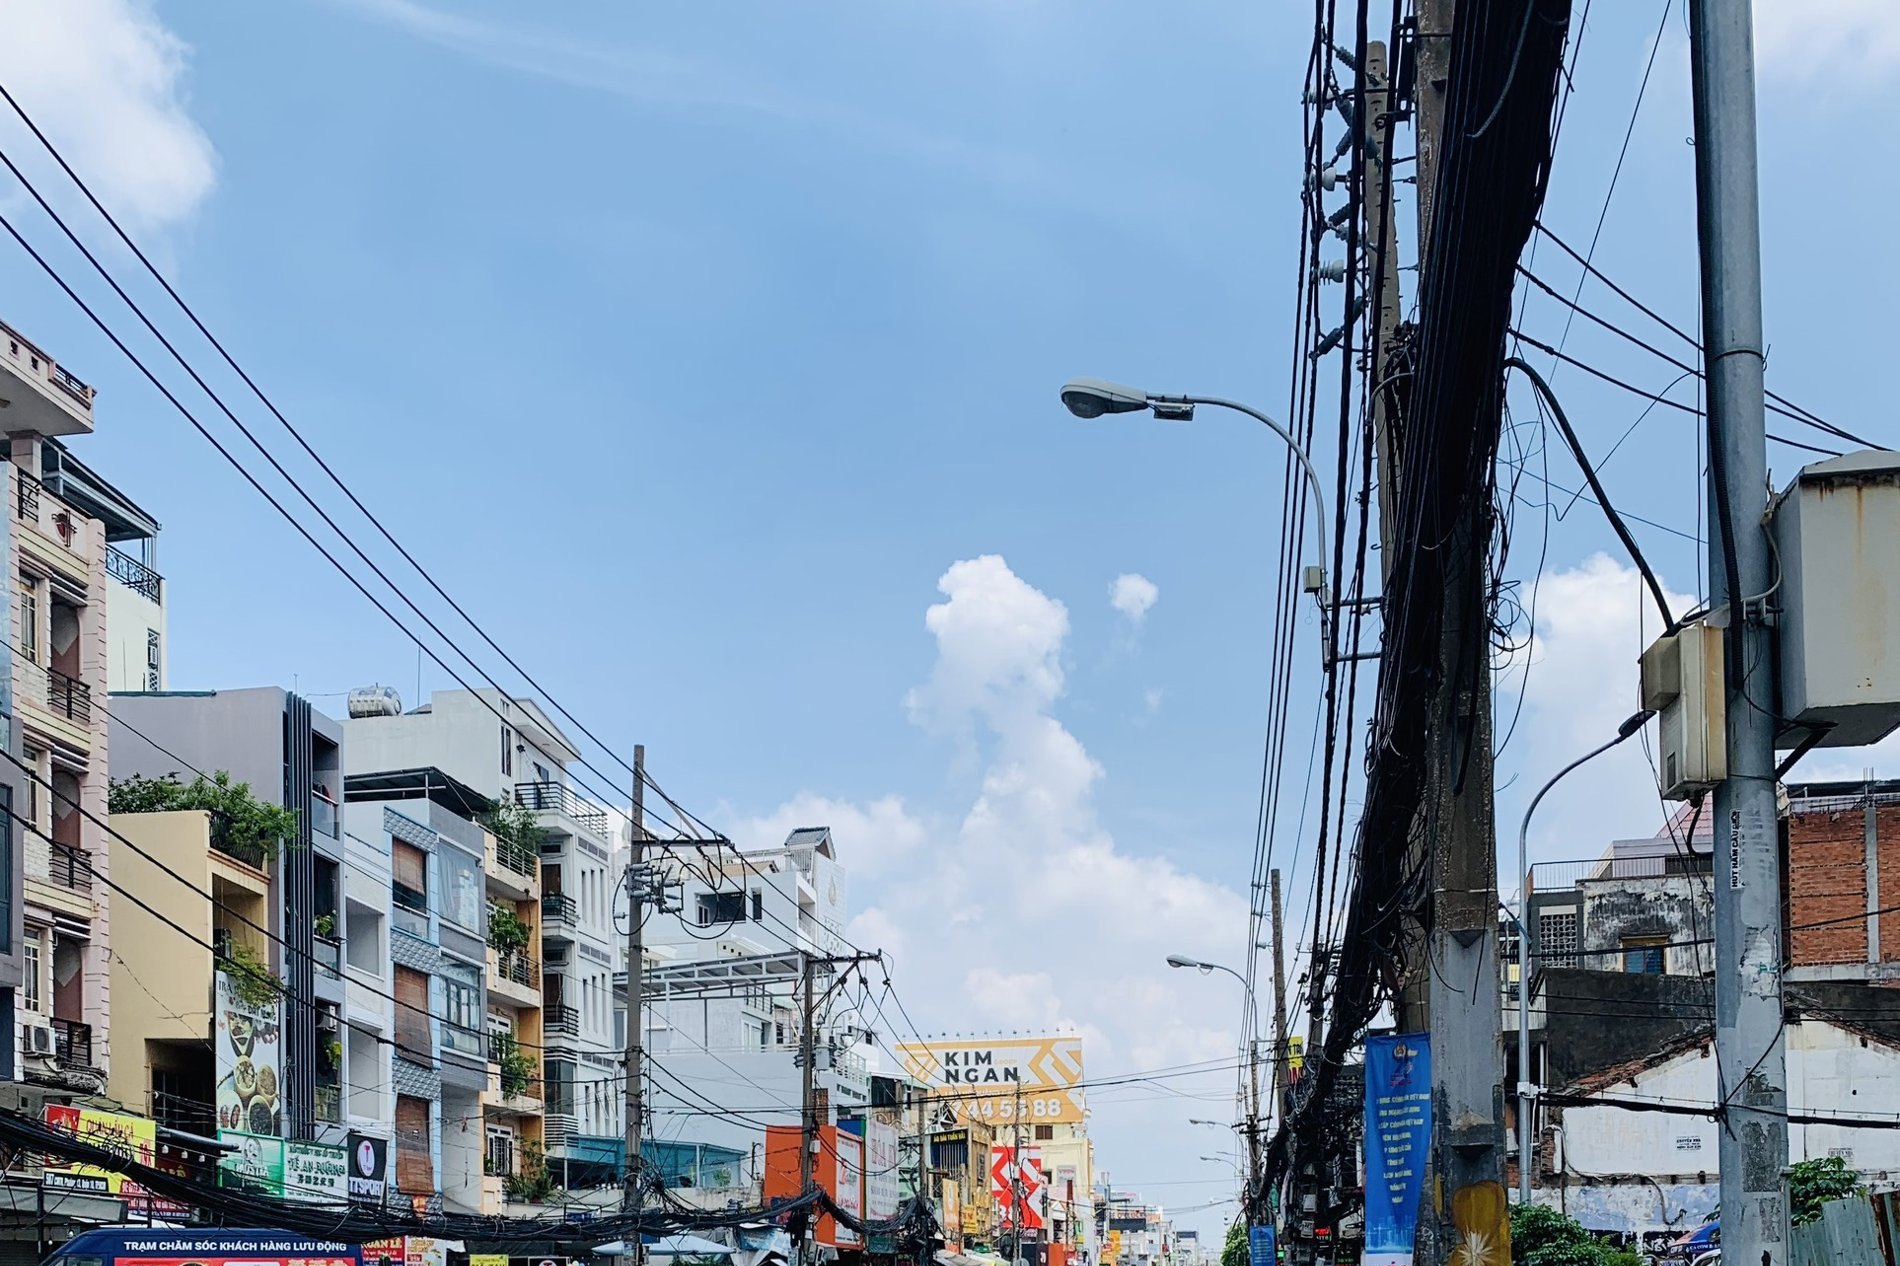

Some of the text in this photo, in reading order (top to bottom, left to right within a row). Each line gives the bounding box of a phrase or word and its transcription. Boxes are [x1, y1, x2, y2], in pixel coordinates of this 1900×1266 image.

[945, 1050, 992, 1066] KIM
[945, 1067, 1018, 1083] NGAN
[966, 1100, 994, 1118] 44
[1033, 1098, 1061, 1117] 88
[124, 1239, 347, 1254] TRẠM CHĂM SÓC KHÁCH HÀNG LƯU ĐỘNG
